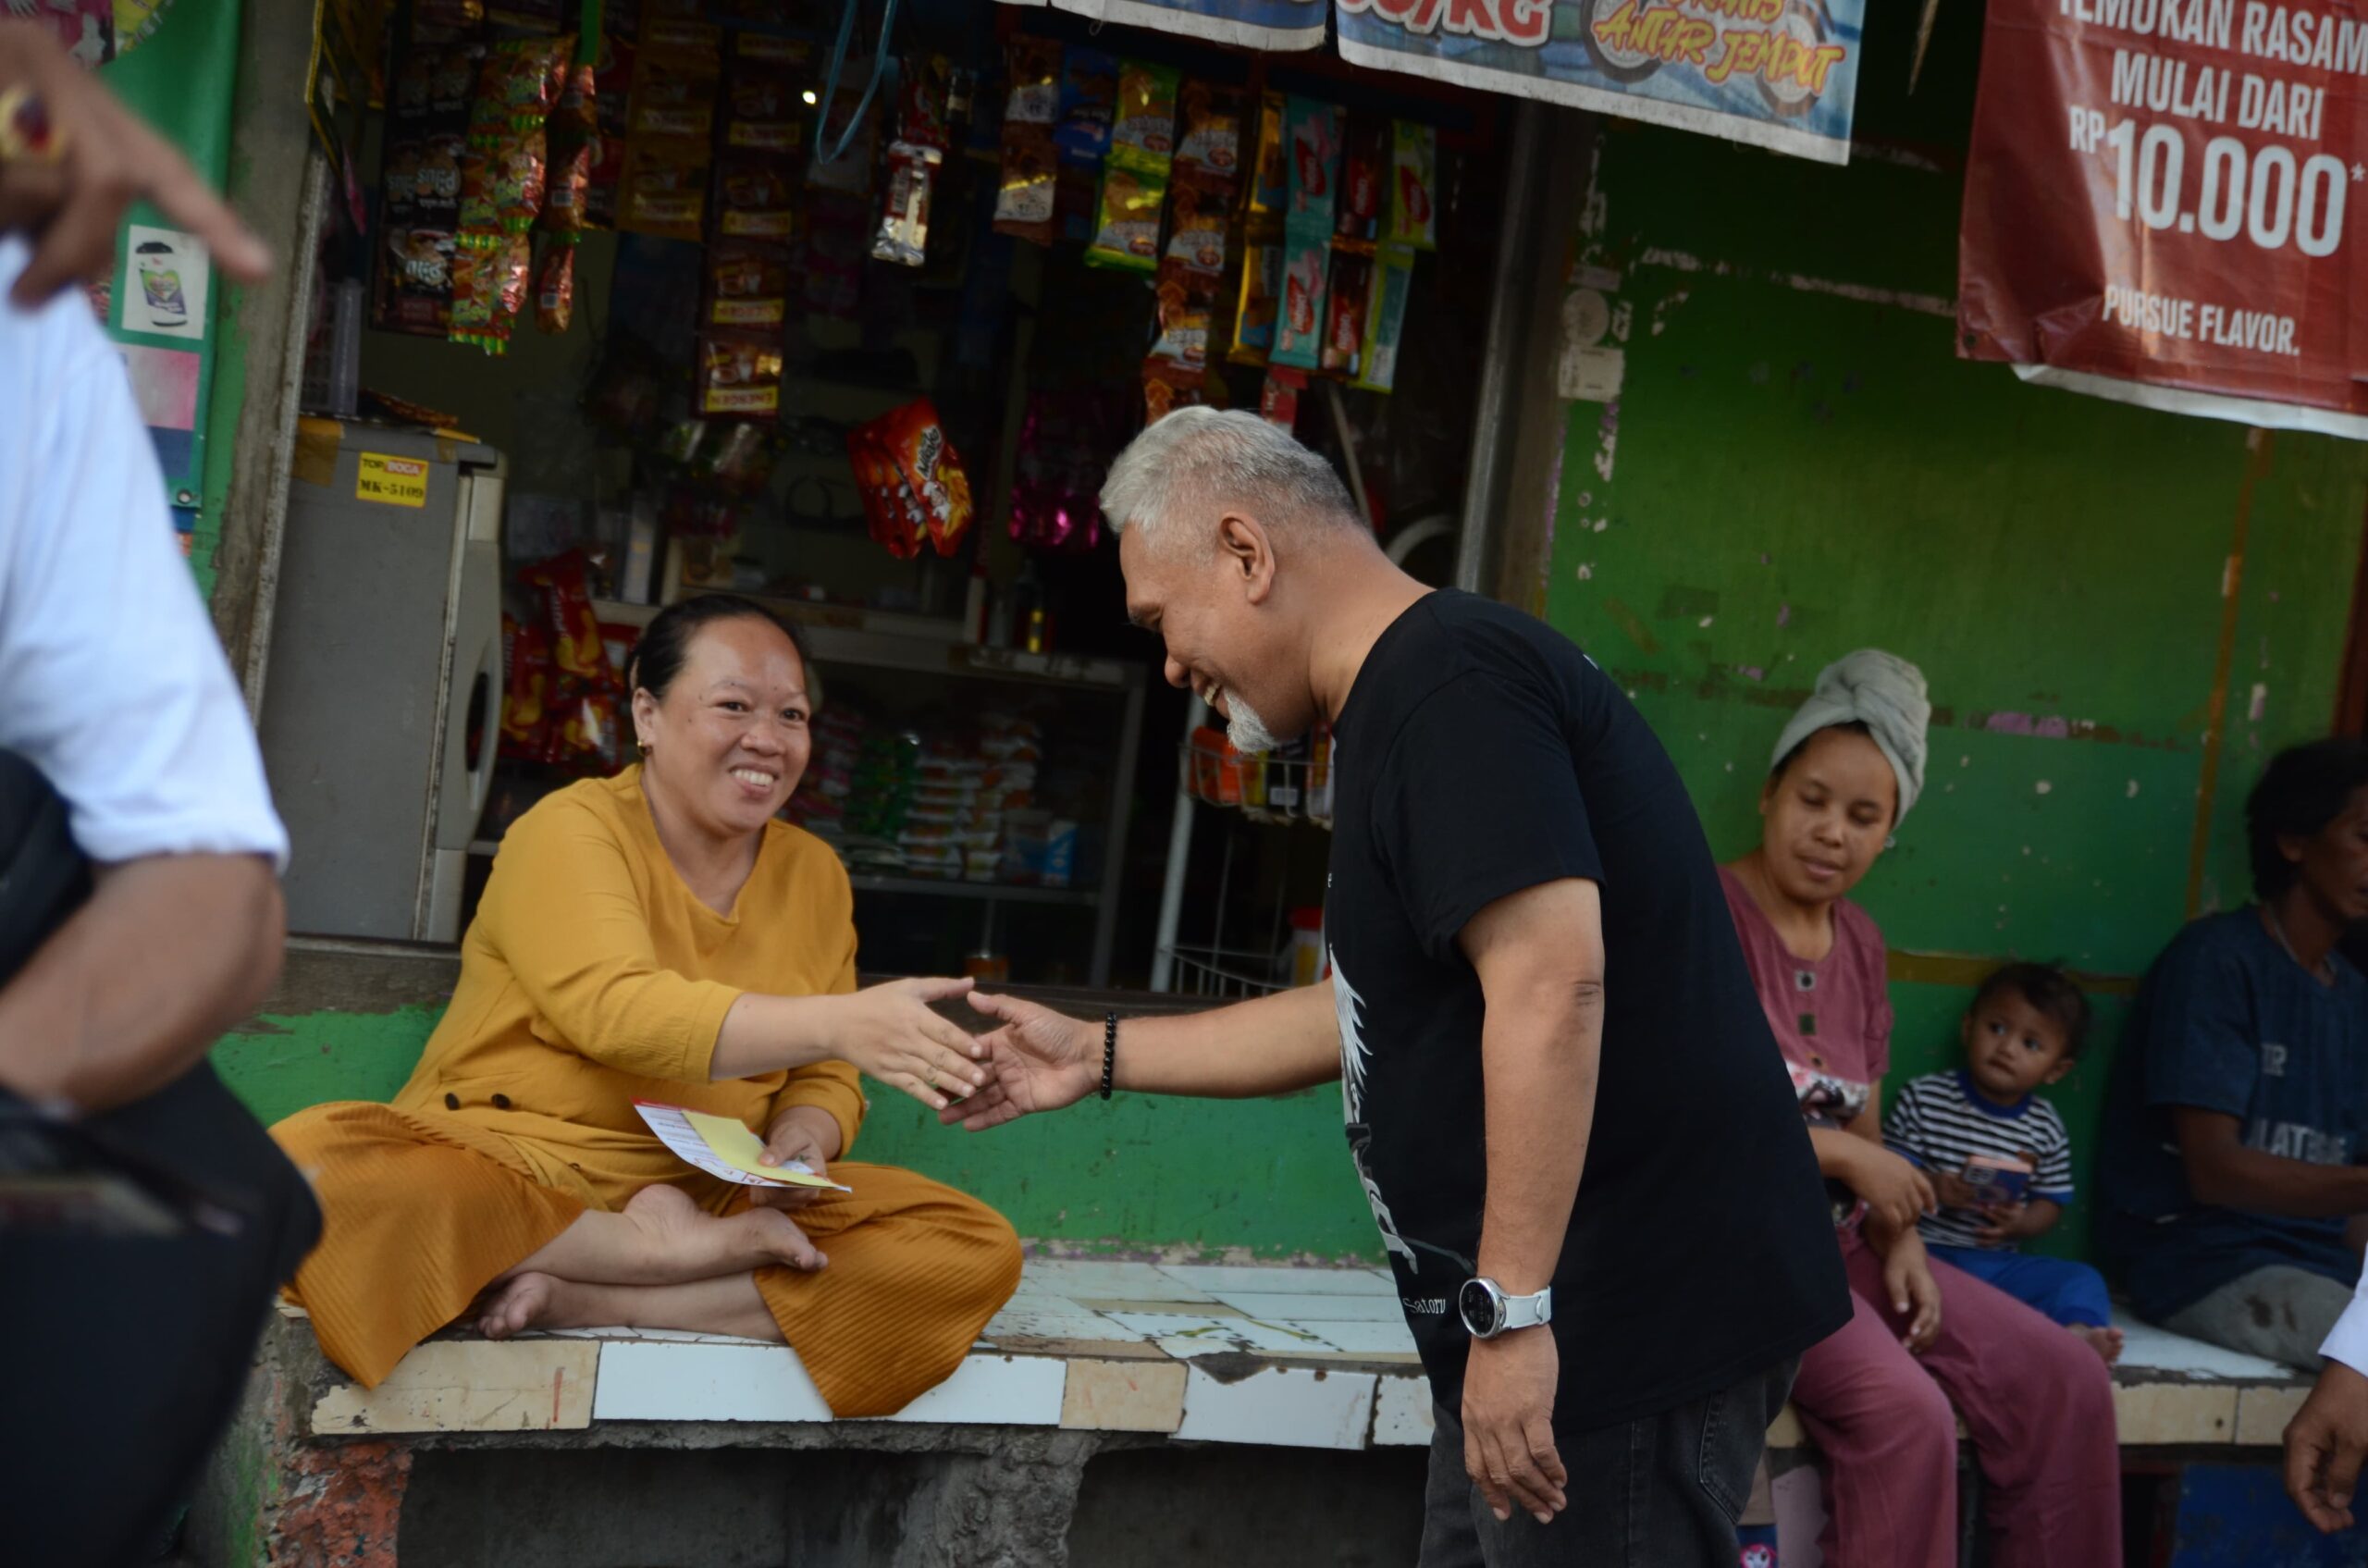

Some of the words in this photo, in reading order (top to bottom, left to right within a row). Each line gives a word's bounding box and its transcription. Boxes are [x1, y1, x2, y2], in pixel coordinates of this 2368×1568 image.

[1595, 2, 1715, 64] ANTAR
[1706, 31, 1844, 92] JEMPUT
[2111, 49, 2231, 123] MULAI
[2238, 74, 2325, 140] DARI
[2102, 284, 2193, 340] PURSUE
[2199, 305, 2300, 355] FLAVOR.
[360, 479, 425, 498] MK-5109
